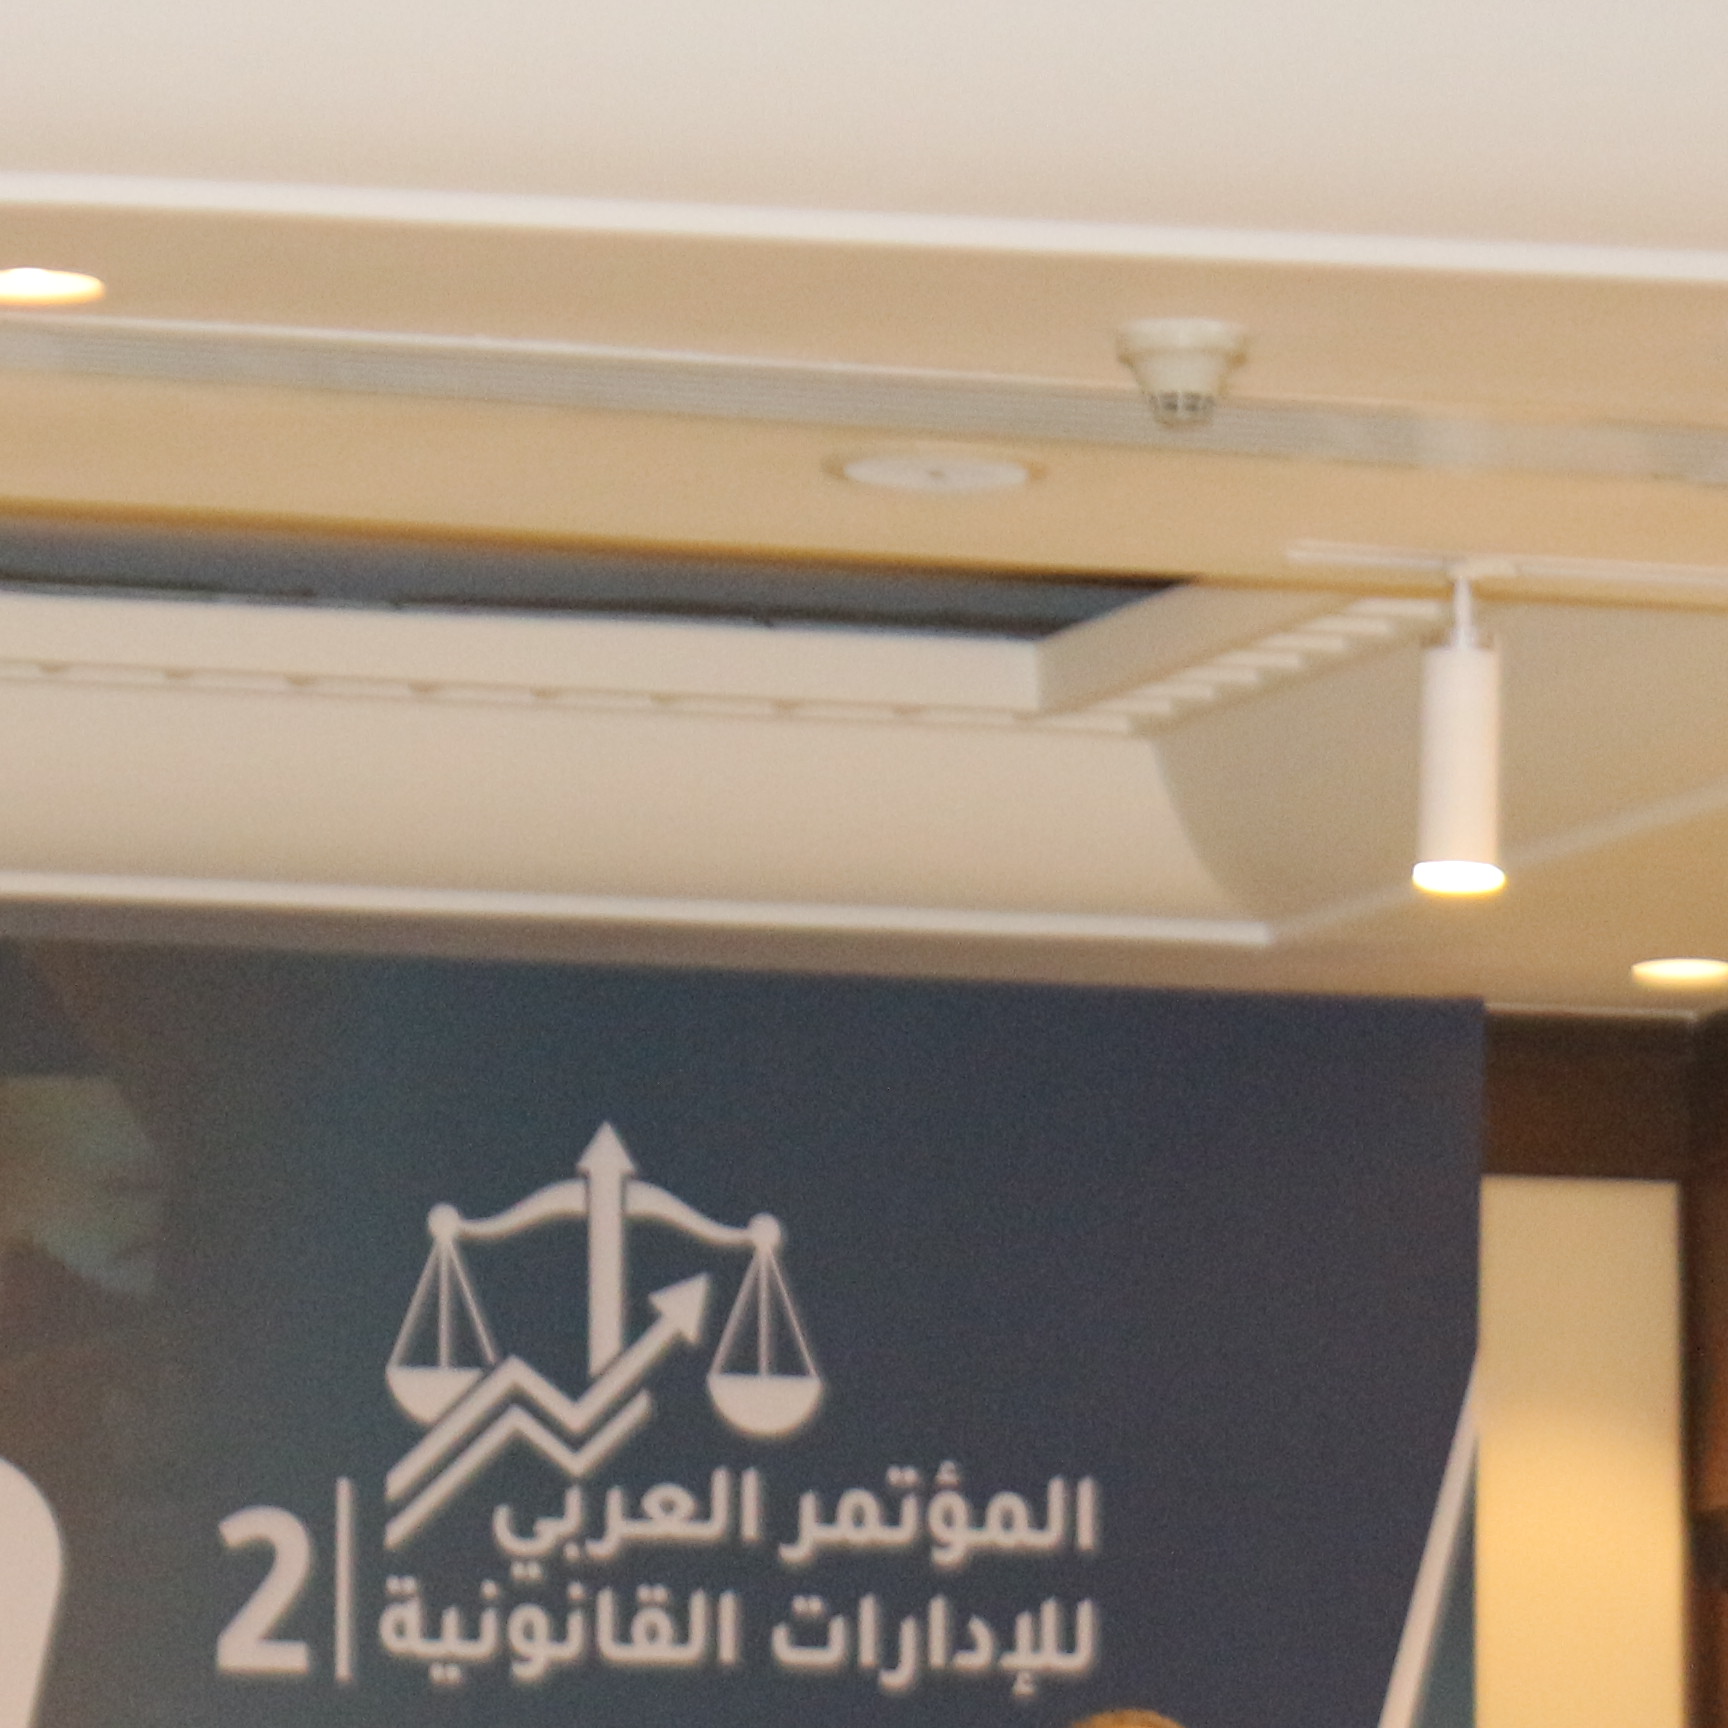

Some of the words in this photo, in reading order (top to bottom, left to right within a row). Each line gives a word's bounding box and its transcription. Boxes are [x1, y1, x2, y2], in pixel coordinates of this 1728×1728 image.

[491, 1465, 760, 1579] العربي
[780, 1460, 1098, 1567] المؤتمر
[215, 1505, 313, 1676] 2
[378, 1576, 740, 1684] القانونية
[769, 1597, 1098, 1695] للإدارات
